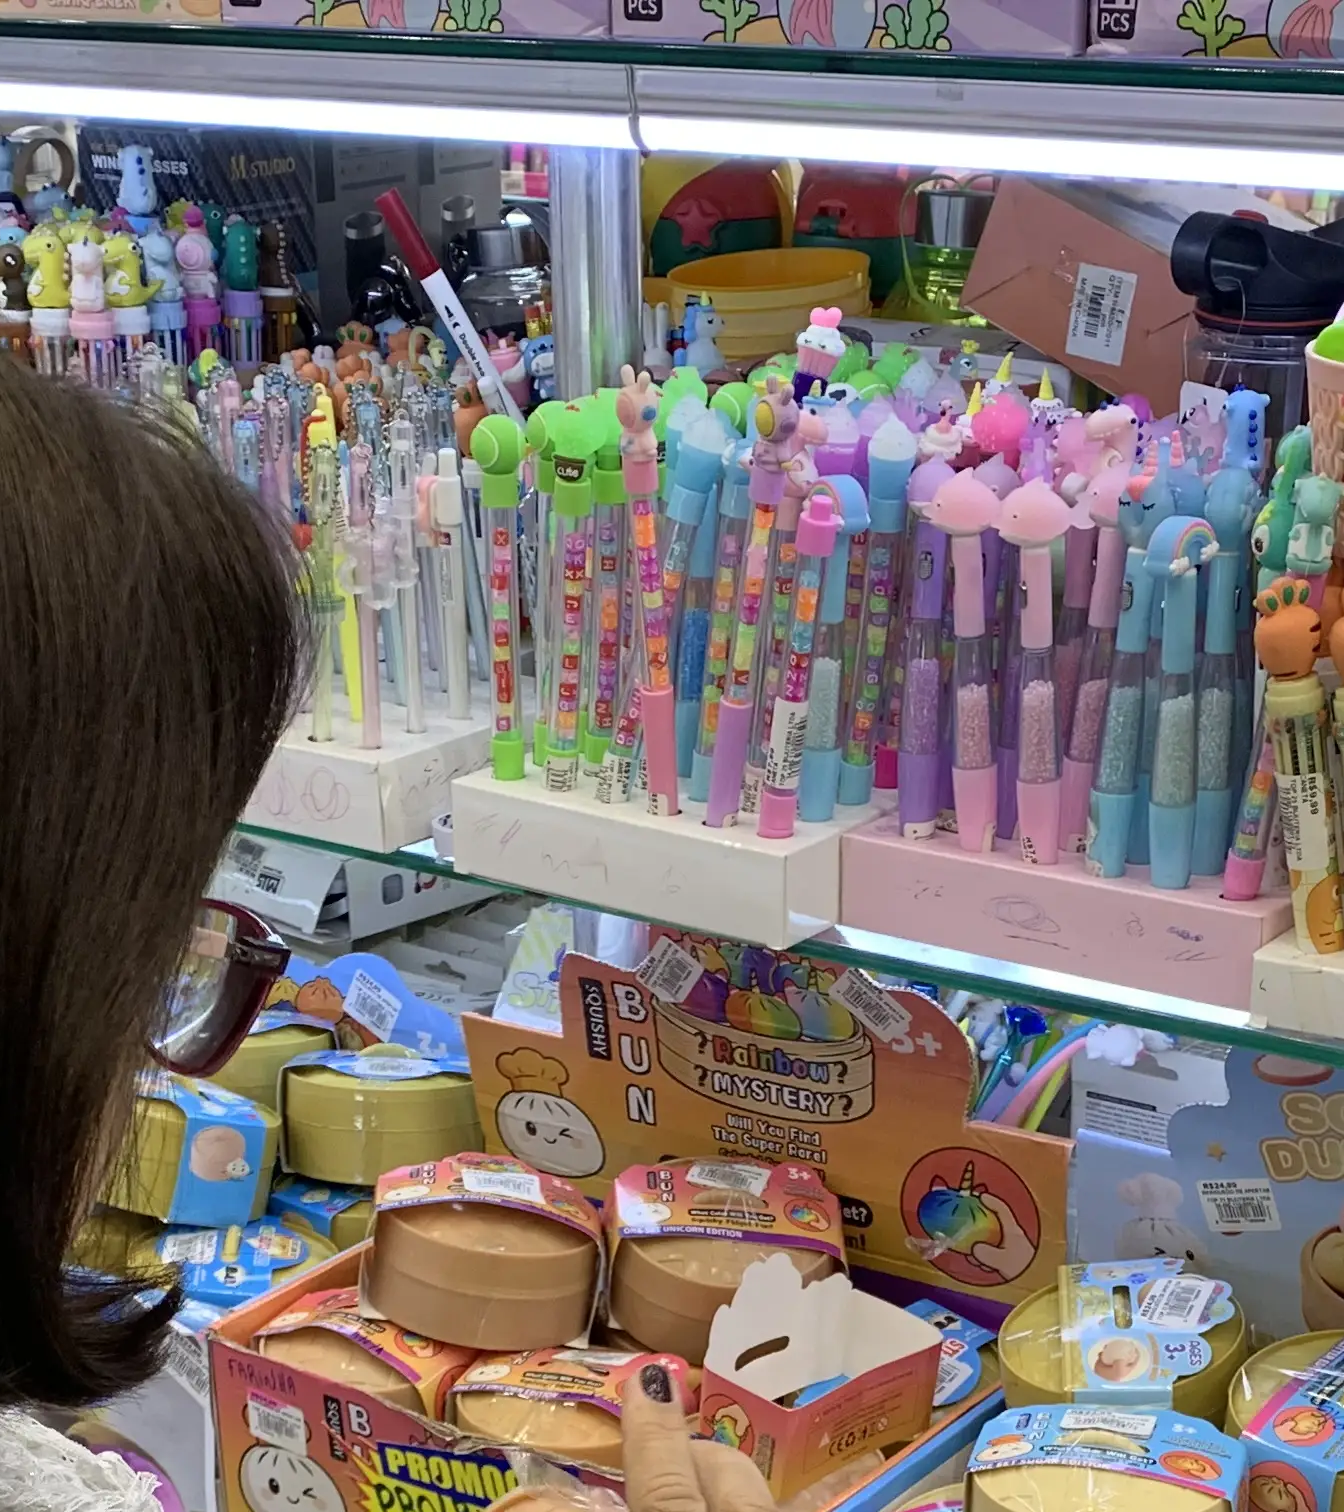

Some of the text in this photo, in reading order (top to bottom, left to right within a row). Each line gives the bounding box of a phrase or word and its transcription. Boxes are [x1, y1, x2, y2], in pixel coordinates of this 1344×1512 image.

[1100, 13, 1132, 33] PCS
[250, 157, 296, 178] STUDIO
[458, 332, 478, 363] Double
[584, 984, 608, 1057] SQUISHY
[611, 981, 657, 1127] BUN
[711, 1034, 830, 1084] Rainbow
[711, 1069, 835, 1117] MYSTERY
[712, 1125, 737, 1144] The
[742, 1131, 784, 1156] Super
[788, 1142, 828, 1164] Rare!
[726, 1113, 821, 1147] Will You Find
[787, 1167, 812, 1181] 3+
[663, 1226, 744, 1239] UNICORN EDITION
[1187, 1340, 1203, 1367] AGES
[384, 1446, 519, 1500] PROMO
